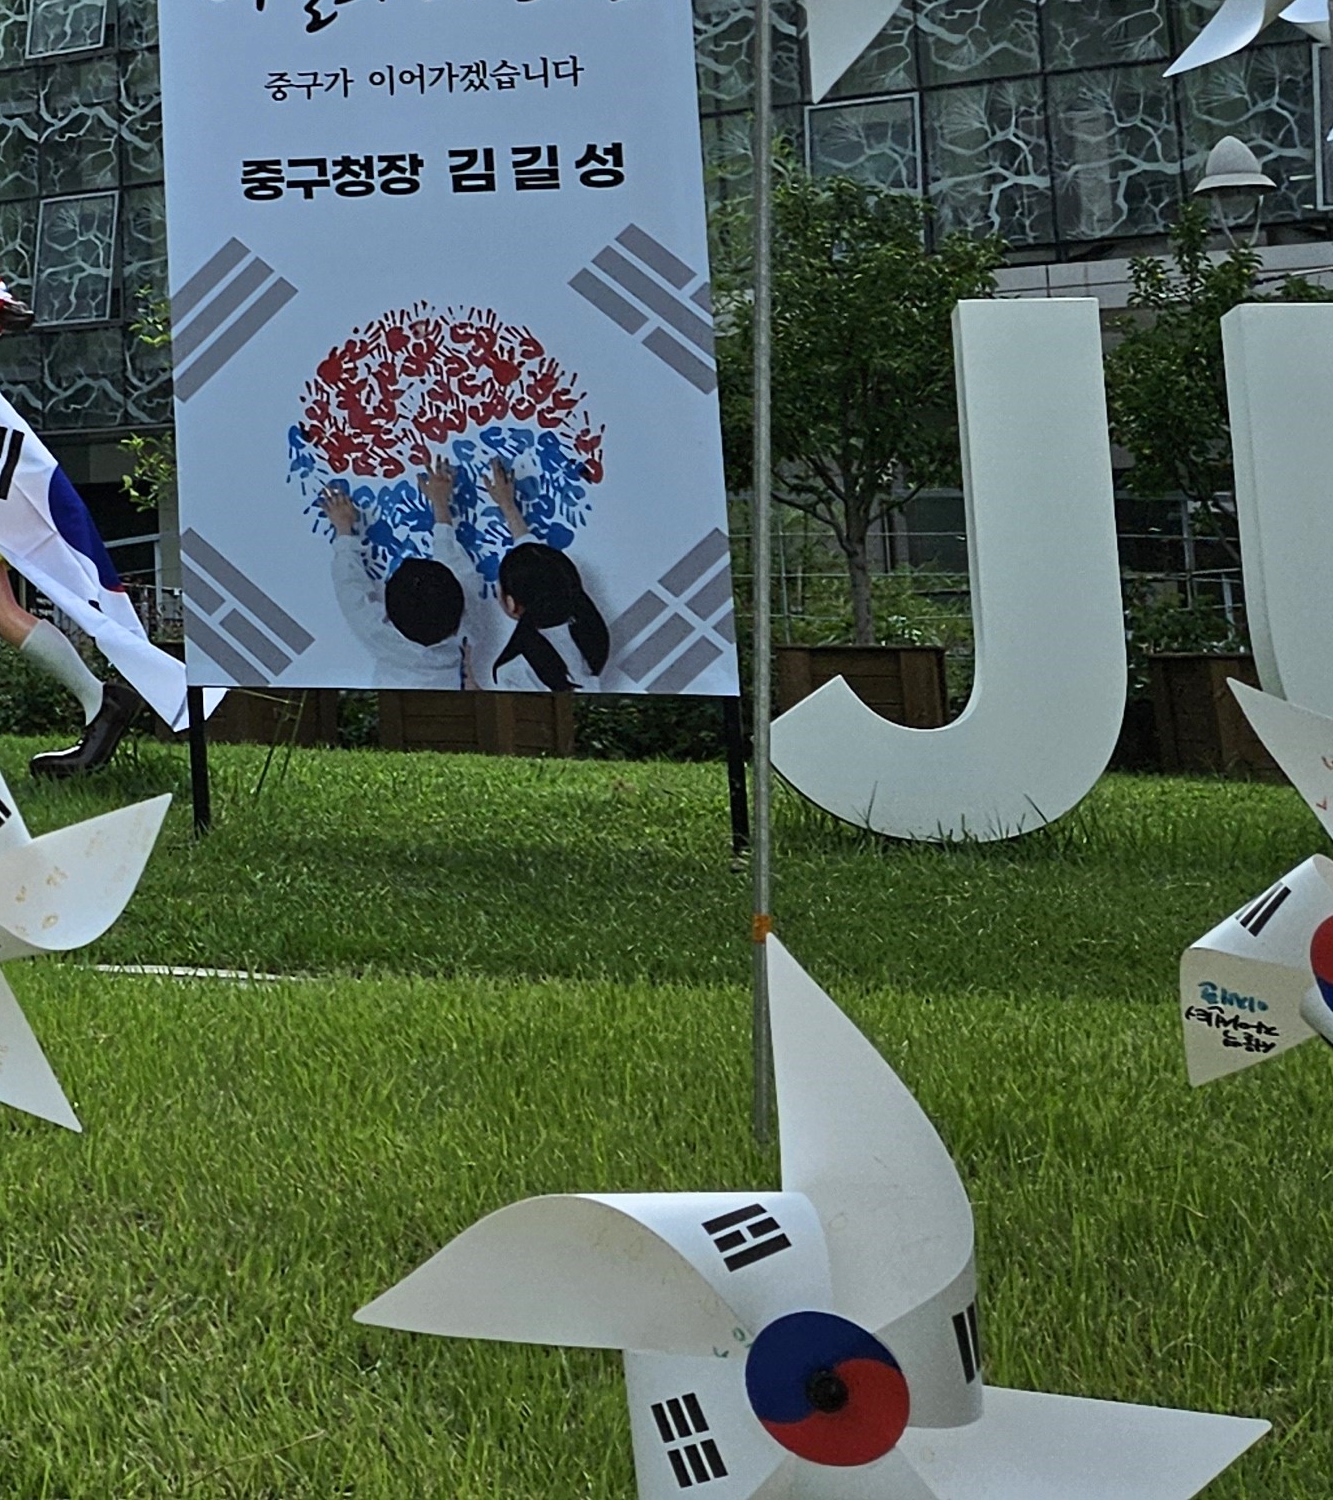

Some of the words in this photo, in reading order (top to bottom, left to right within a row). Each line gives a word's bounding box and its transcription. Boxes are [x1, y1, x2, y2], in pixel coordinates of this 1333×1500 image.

[263, 66, 355, 102] 중구가
[367, 55, 585, 97] 이어가겠습니다
[240, 154, 424, 201] 중구청장
[446, 140, 627, 193] 김길성
